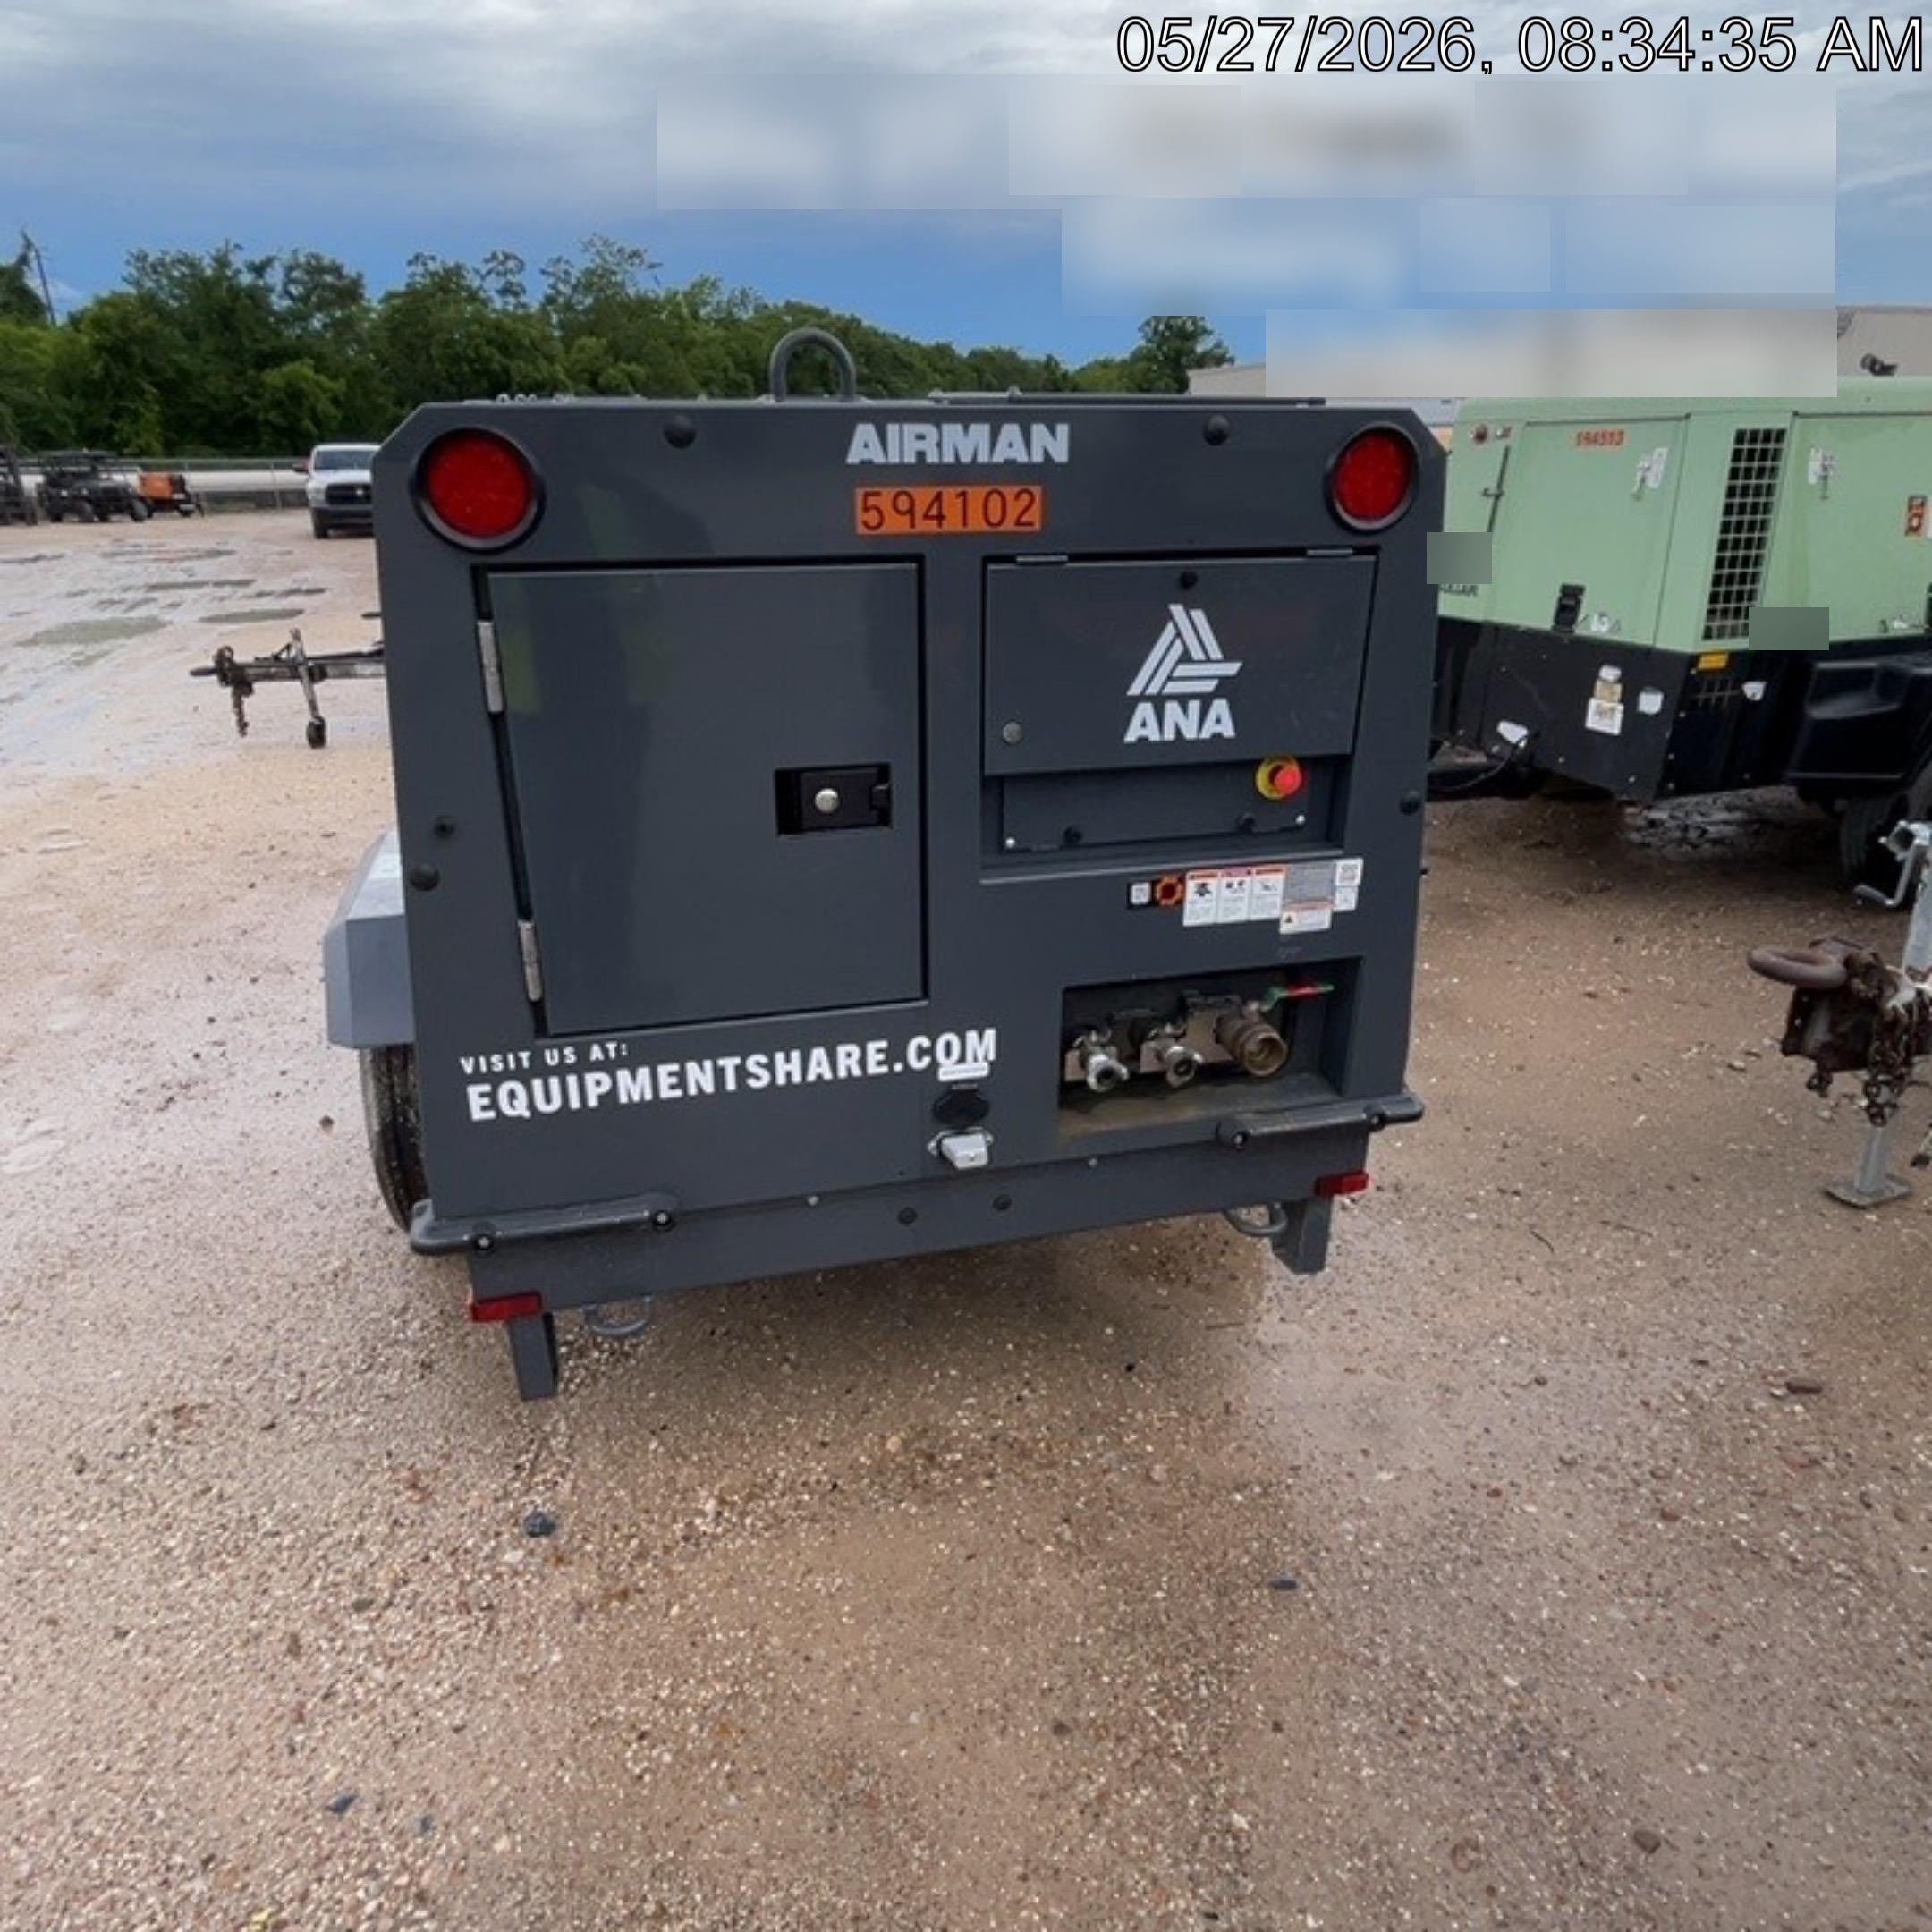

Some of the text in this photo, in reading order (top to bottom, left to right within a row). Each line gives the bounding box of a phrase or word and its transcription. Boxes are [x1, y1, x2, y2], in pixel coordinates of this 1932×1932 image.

[846, 422, 1070, 464] AIRMAN
[860, 488, 1037, 530] 594102
[1123, 699, 1235, 743] ANA
[460, 1040, 628, 1075] VISIT US AT:
[466, 1027, 997, 1122] EQUIPMENTSHARE.COM
